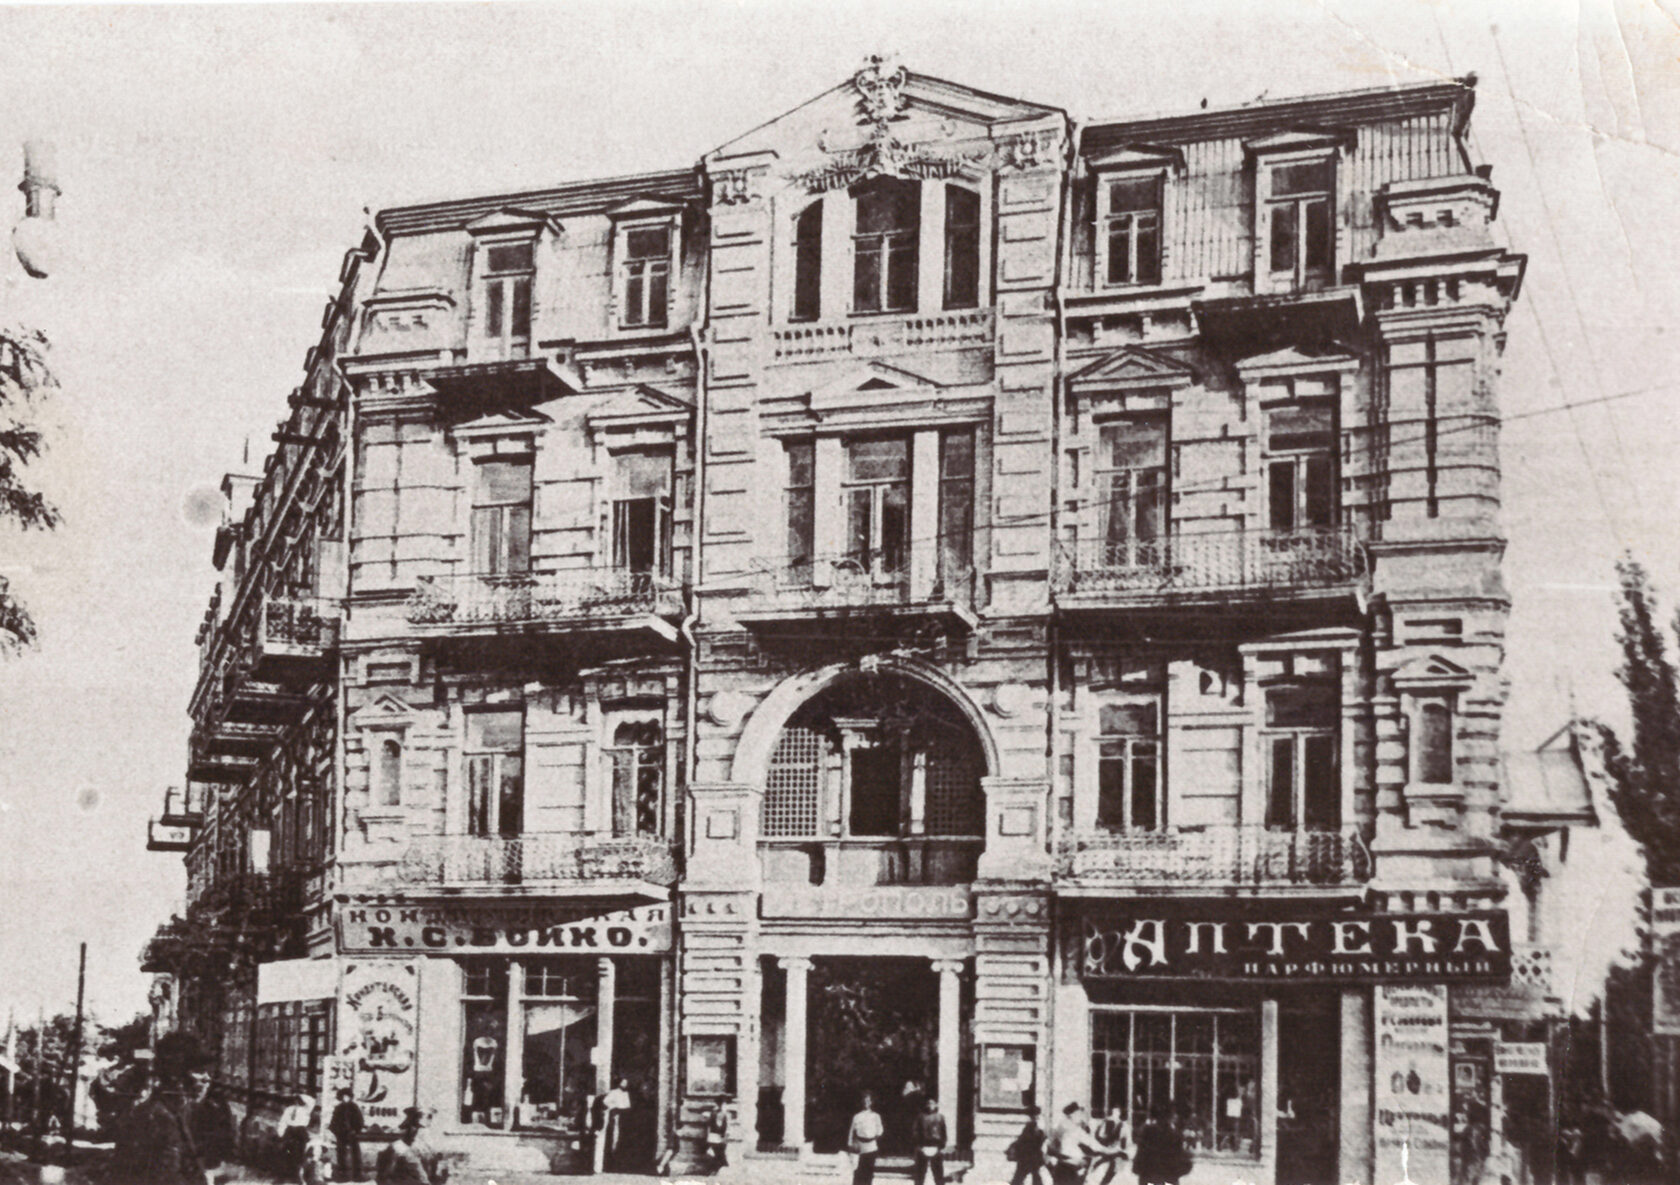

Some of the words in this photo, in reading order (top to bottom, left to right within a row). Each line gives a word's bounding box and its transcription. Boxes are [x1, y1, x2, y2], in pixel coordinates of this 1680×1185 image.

[766, 892, 967, 914] РОПОЛЬ
[349, 908, 664, 923] КОНДКАЯ
[1123, 919, 1501, 972] АПТЕКА
